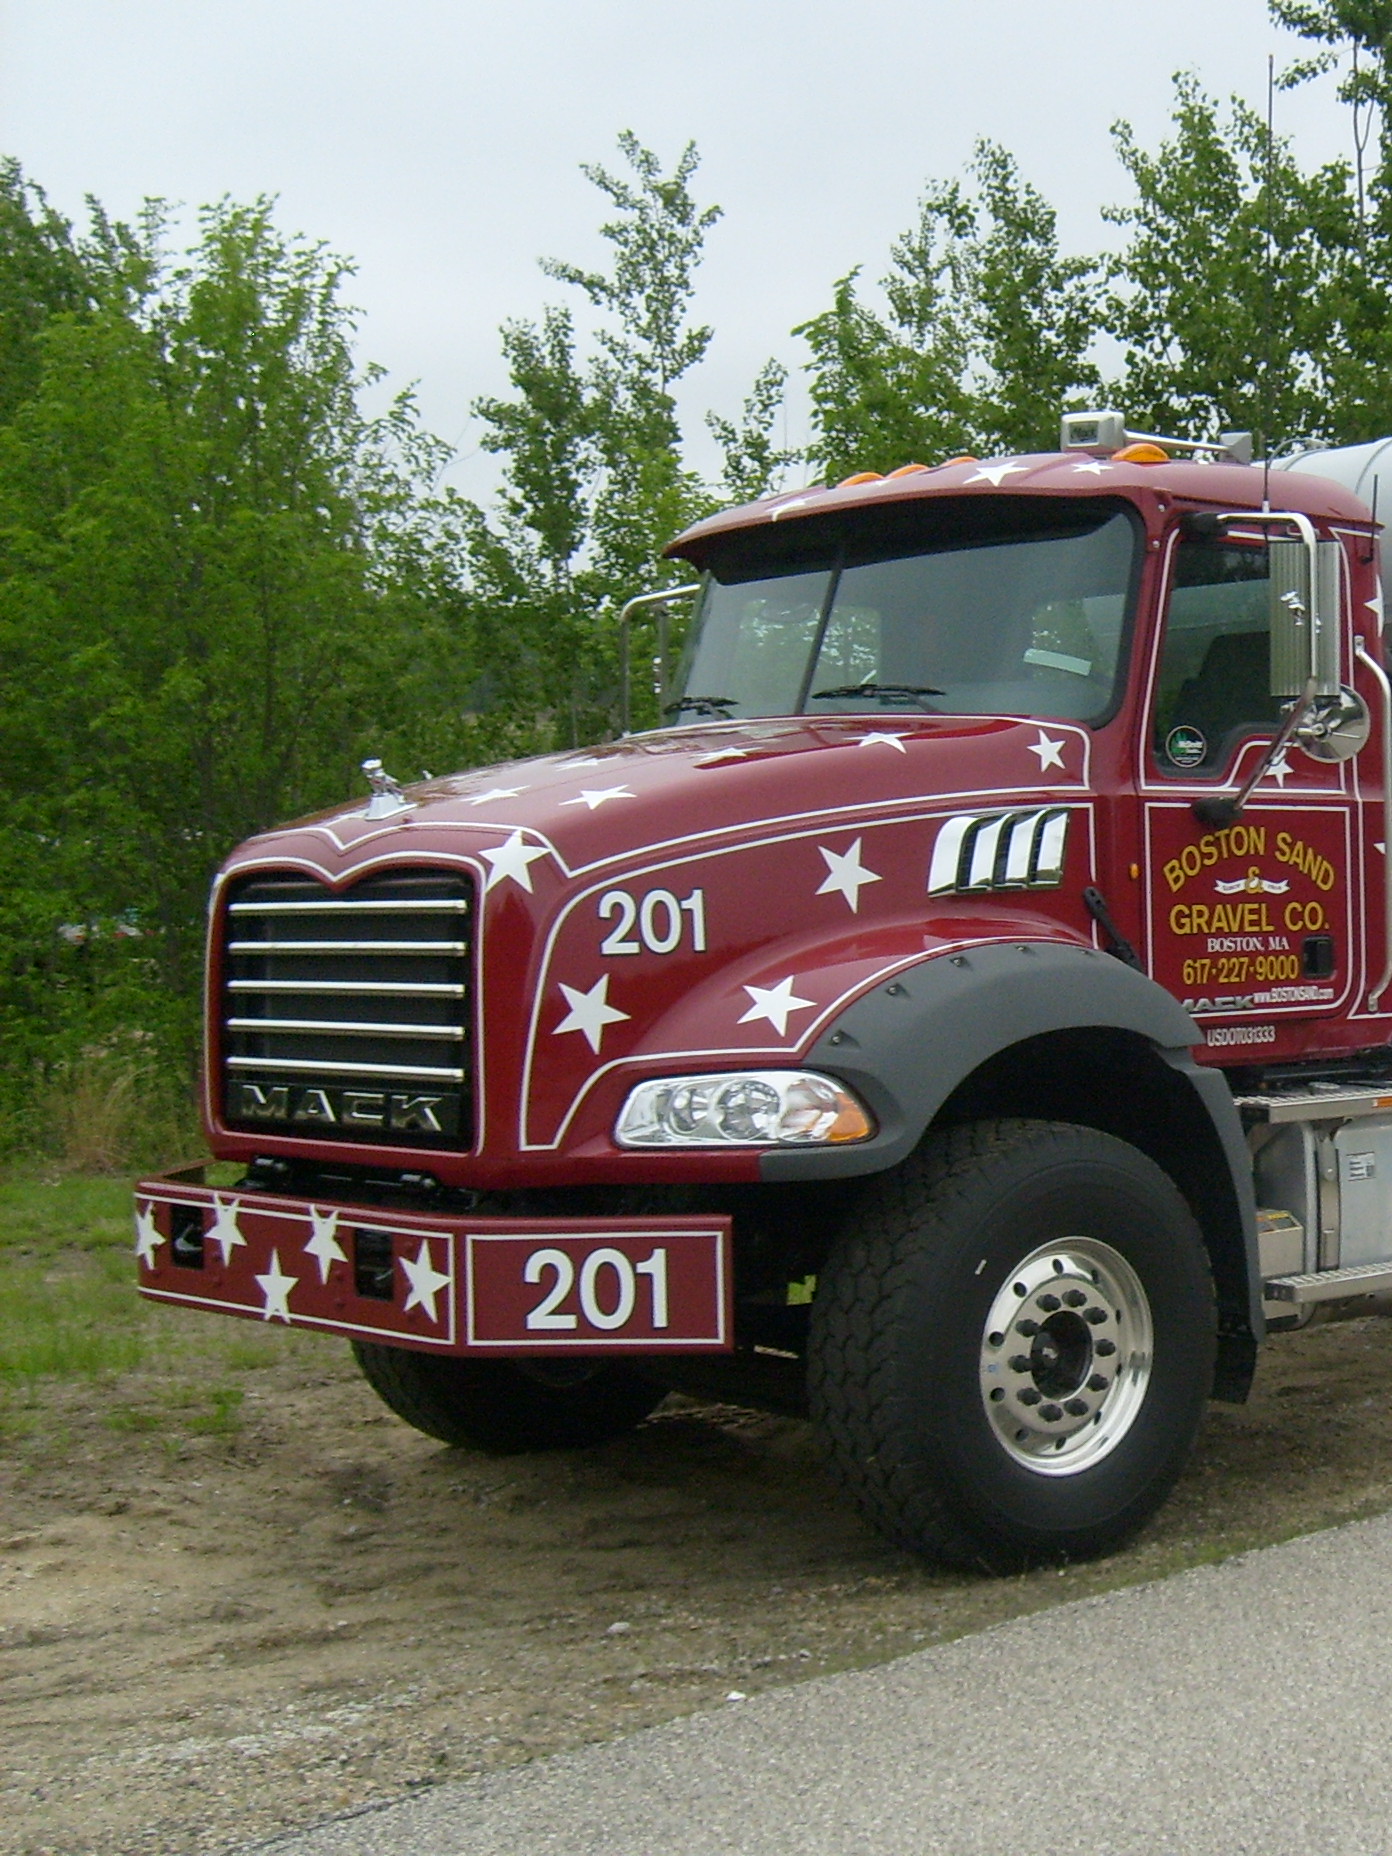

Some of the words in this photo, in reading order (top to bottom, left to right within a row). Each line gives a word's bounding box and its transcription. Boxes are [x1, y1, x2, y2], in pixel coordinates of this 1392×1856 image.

[1163, 826, 1266, 893] BOSTON
[1275, 832, 1335, 891] SAND
[598, 888, 706, 955] 201
[1169, 903, 1276, 935] GRAVEL
[1284, 901, 1330, 931] CO.
[1268, 936, 1290, 951] MA
[241, 1084, 443, 1132] MACK
[523, 1247, 669, 1330] 201
